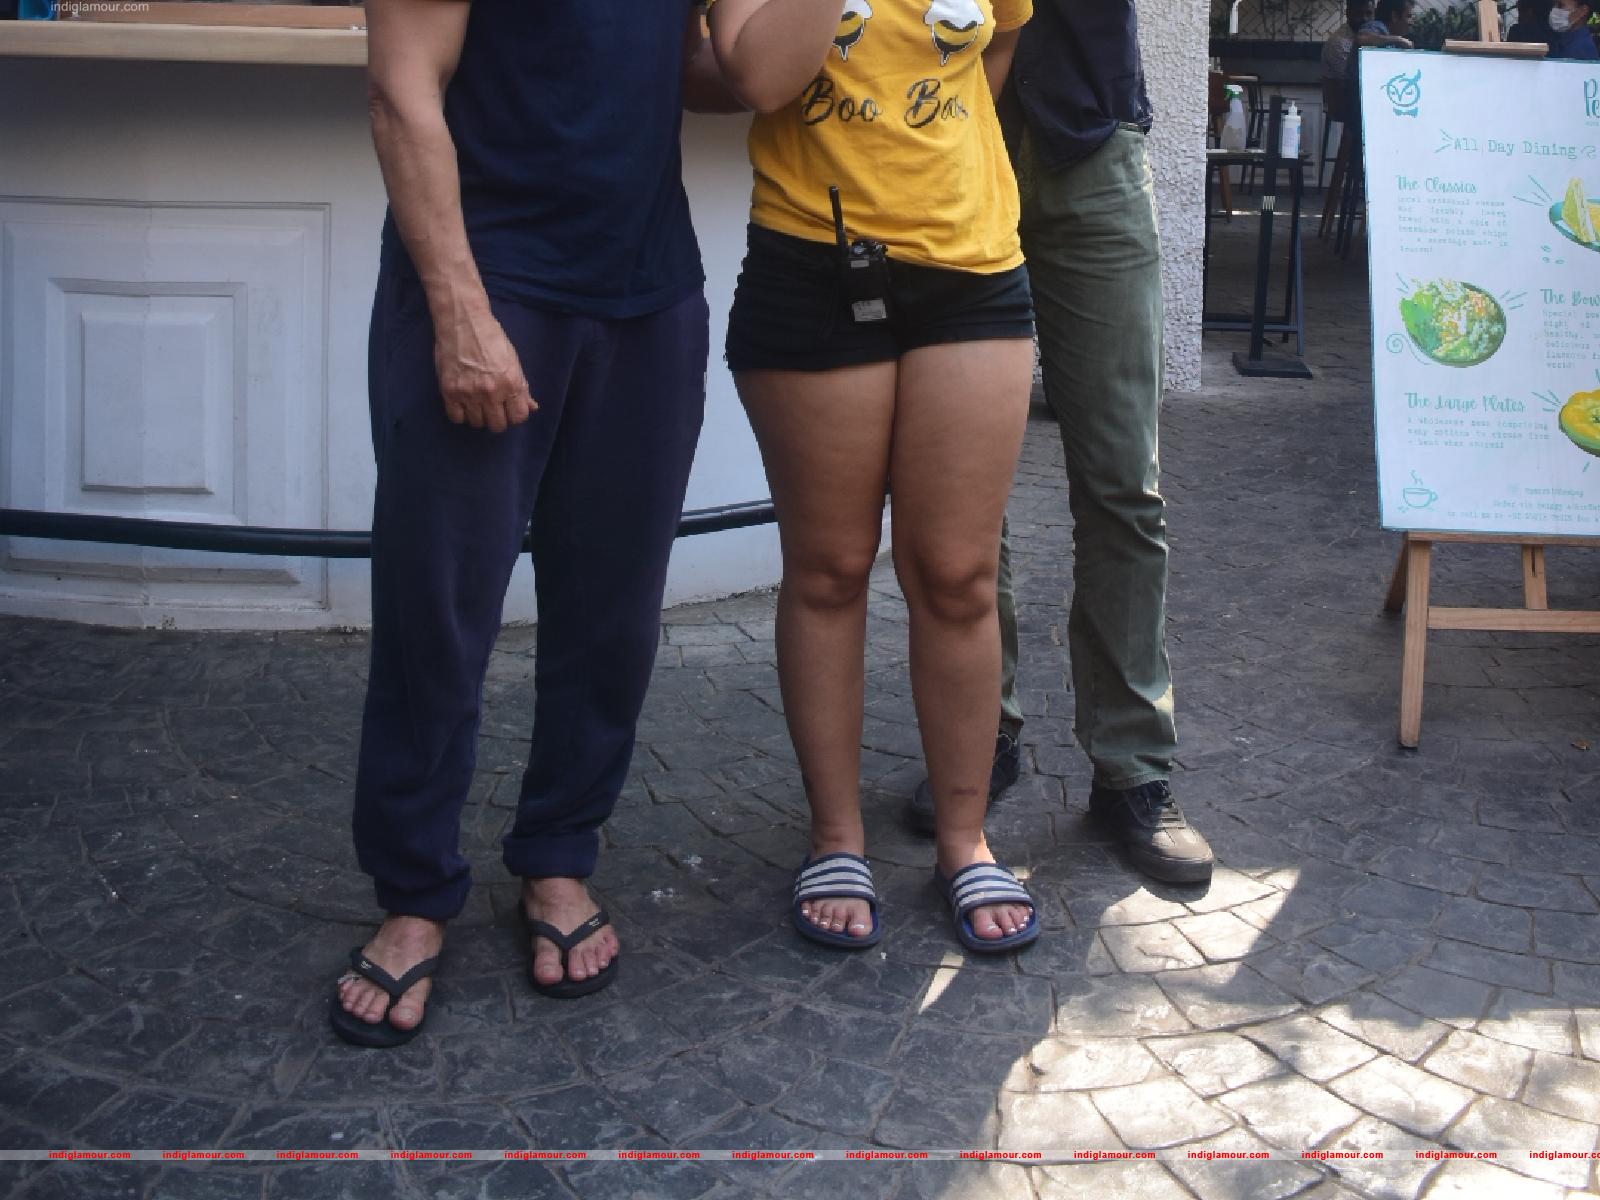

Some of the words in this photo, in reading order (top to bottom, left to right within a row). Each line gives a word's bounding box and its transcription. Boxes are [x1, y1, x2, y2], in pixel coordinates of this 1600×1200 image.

[801, 75, 883, 126] Boo
[1454, 137, 1480, 151] All
[1487, 139, 1515, 157] Day
[1522, 140, 1578, 160] Dining
[1540, 288, 1566, 304] The
[1404, 392, 1430, 409] The
[1482, 394, 1526, 413] Plates
